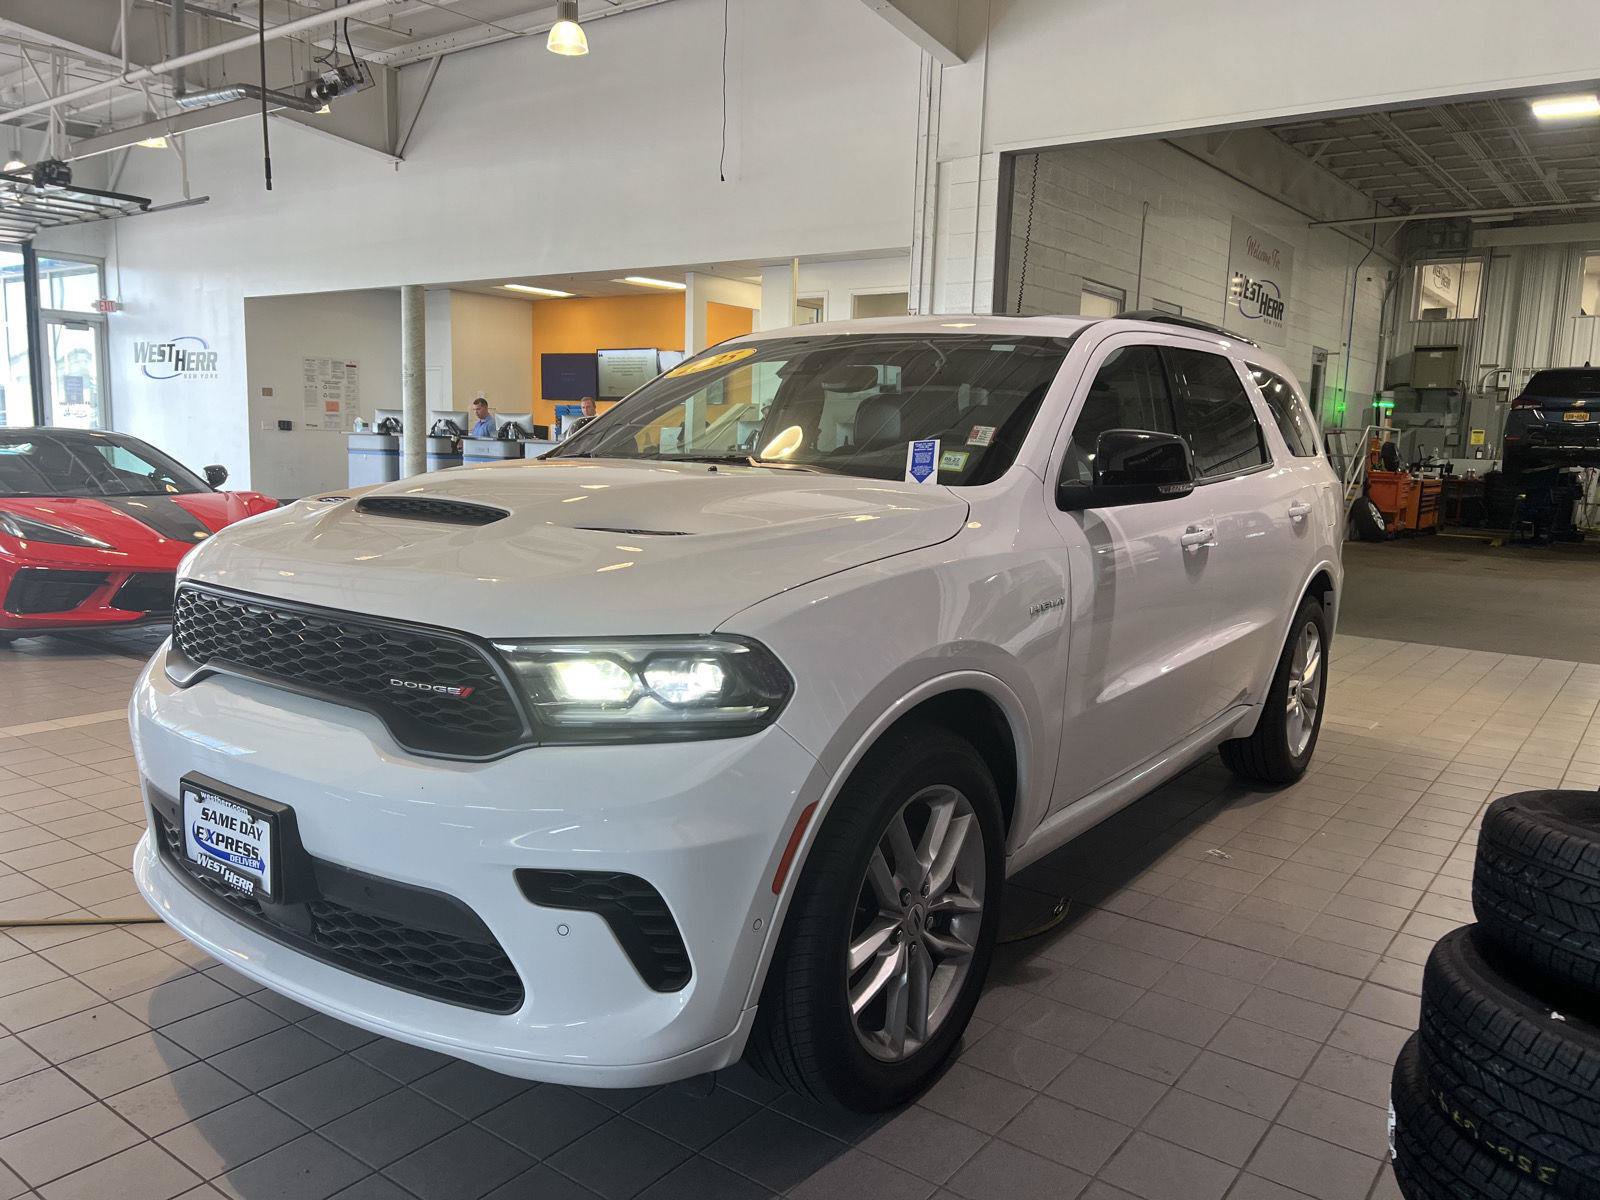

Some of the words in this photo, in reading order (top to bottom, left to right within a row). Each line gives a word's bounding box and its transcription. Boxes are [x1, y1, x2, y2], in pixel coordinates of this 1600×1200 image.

[1231, 271, 1263, 303] WEST
[1259, 292, 1285, 321] HERR
[133, 341, 176, 363] WEST
[174, 349, 218, 371] HERR
[390, 678, 461, 695] DODGE
[200, 791, 249, 815] westherr.com
[201, 807, 237, 832] SAME
[239, 820, 263, 842] DAY
[195, 825, 260, 860] EXPRESS
[196, 852, 228, 875] WEST
[223, 870, 254, 893] HERR
[230, 854, 260, 869] DELIVERY
